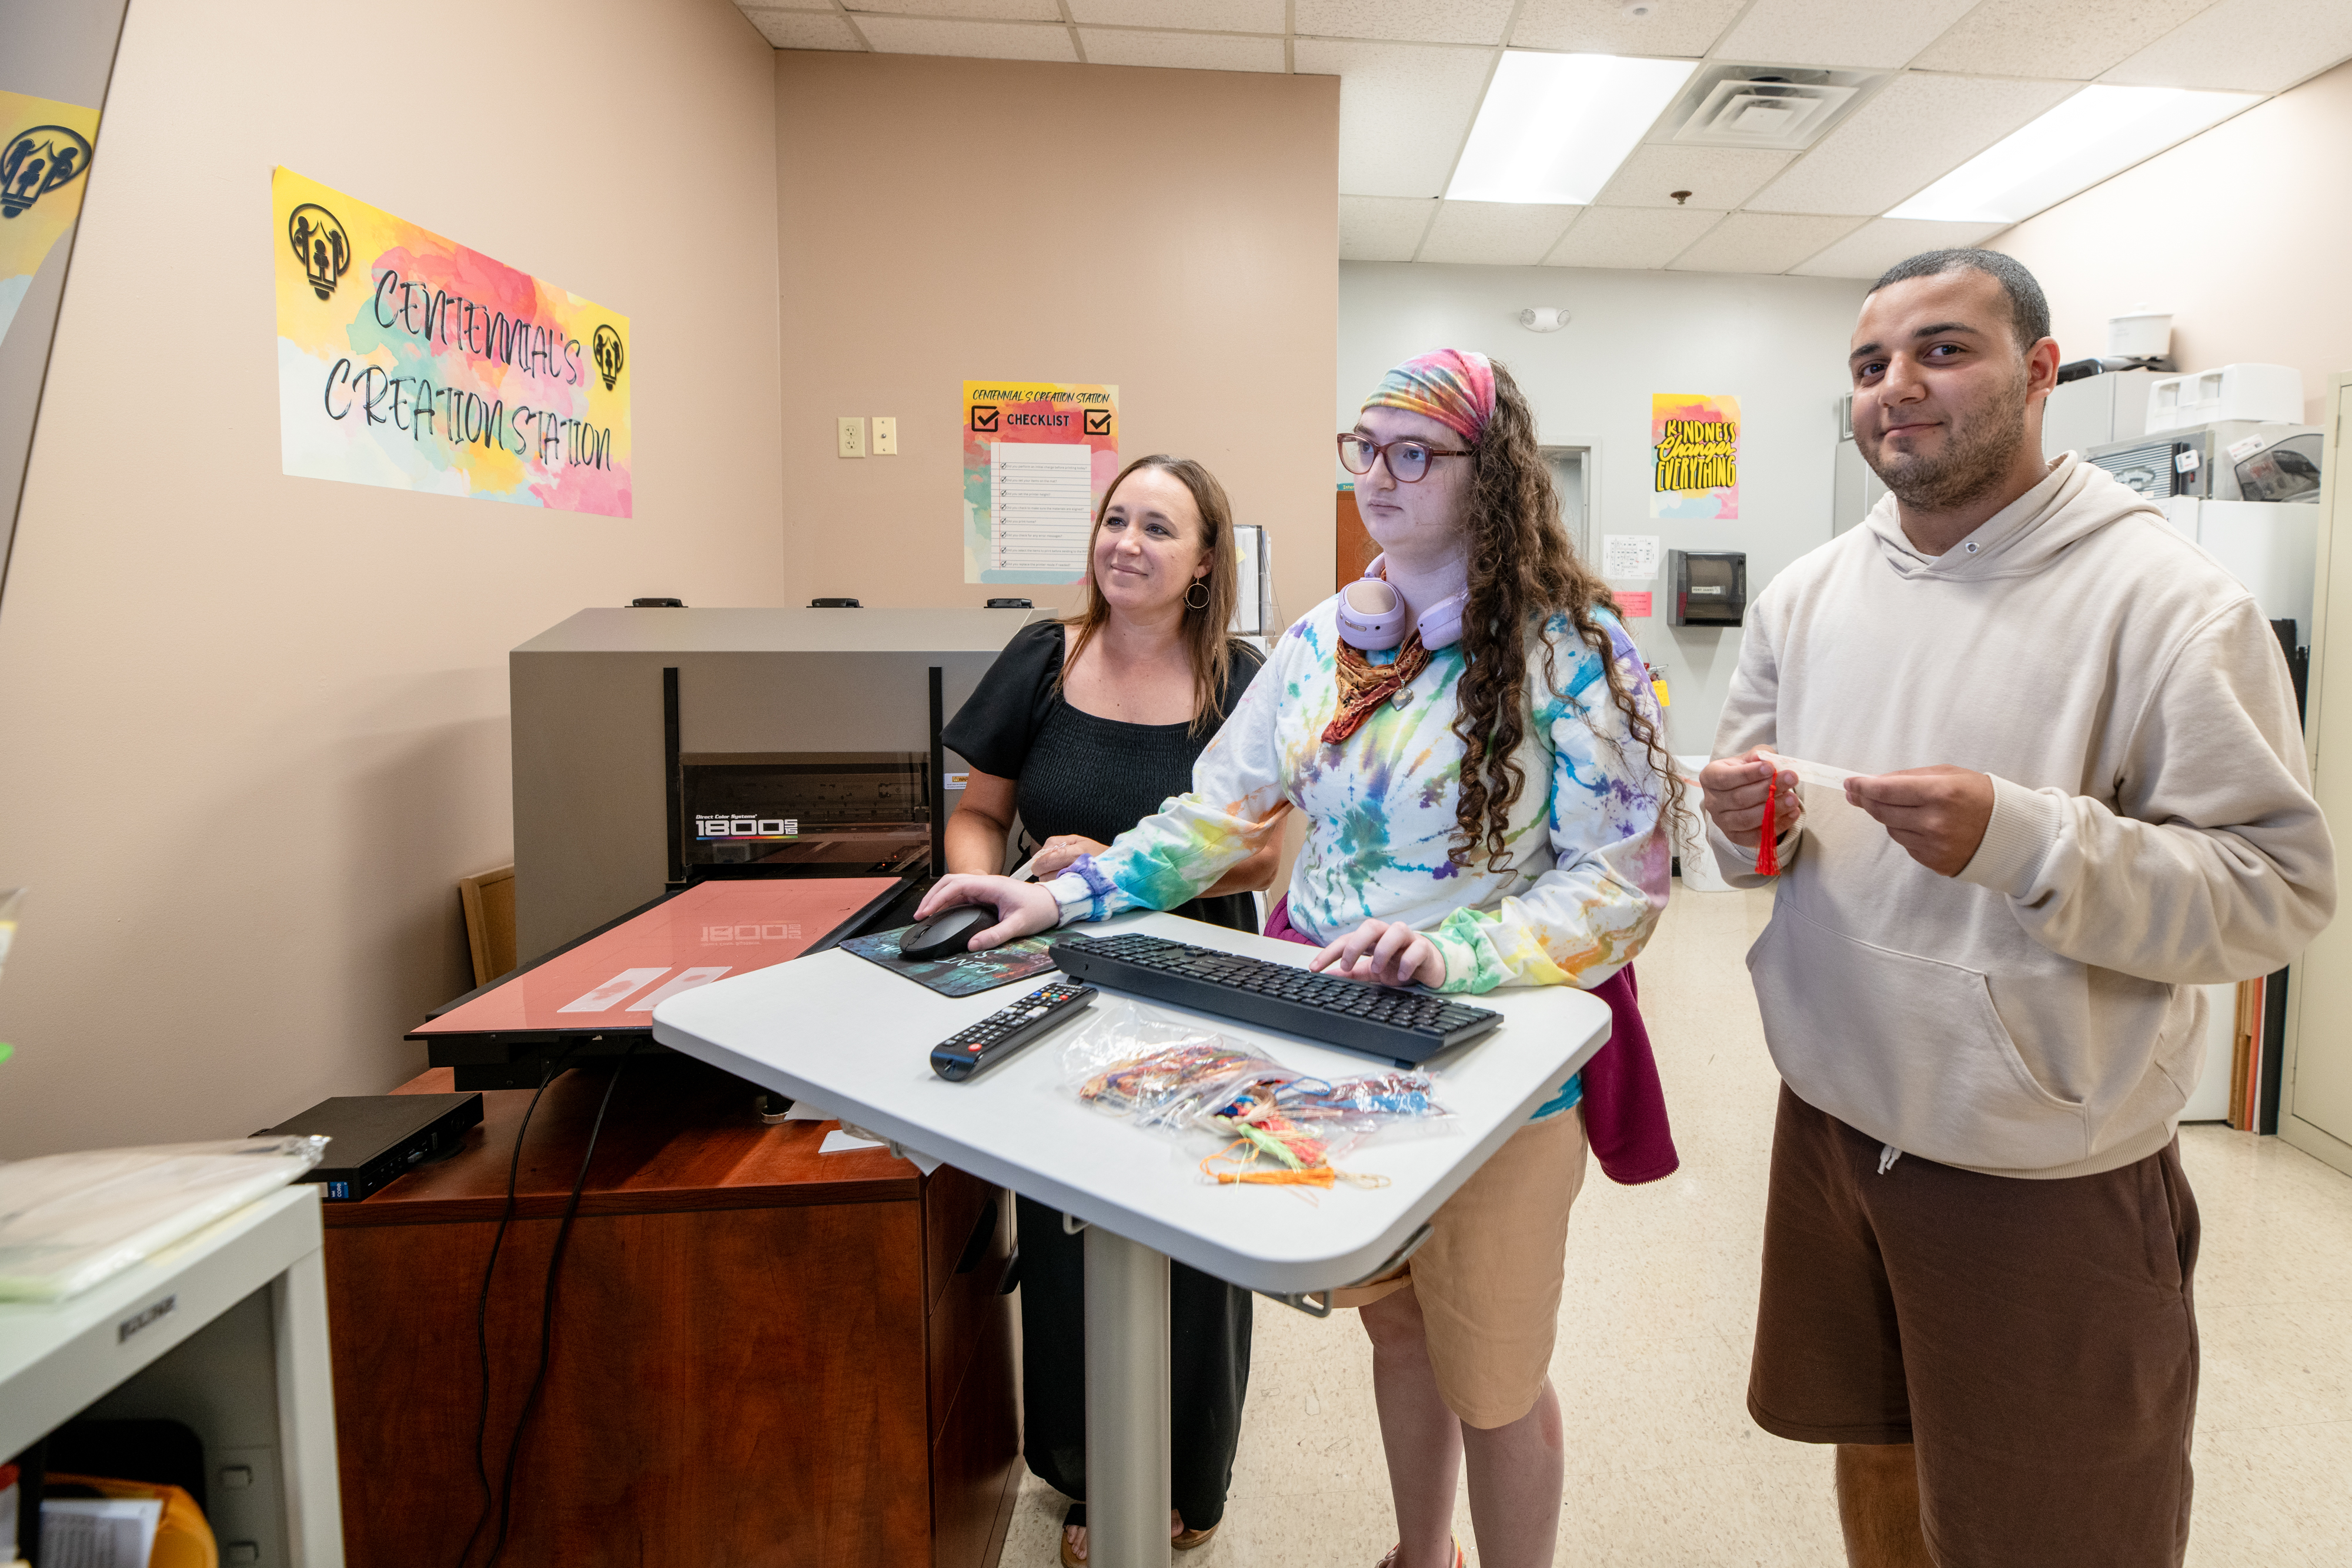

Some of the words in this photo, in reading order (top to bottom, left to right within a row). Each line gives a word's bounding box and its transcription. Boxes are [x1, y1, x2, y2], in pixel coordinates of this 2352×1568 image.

[375, 270, 580, 385] CENTENNIAL'S
[973, 389, 1033, 402] CENTENNIAL'S
[1034, 391, 1075, 403] CREATION
[1076, 393, 1111, 404] STATION
[324, 358, 505, 450] CREATION
[512, 406, 612, 472] STATION
[1007, 413, 1070, 427] CHECKLIST
[1665, 419, 1736, 443] KINDNESS
[1654, 435, 1737, 463] Changes
[1655, 456, 1736, 492] EVERYTHING
